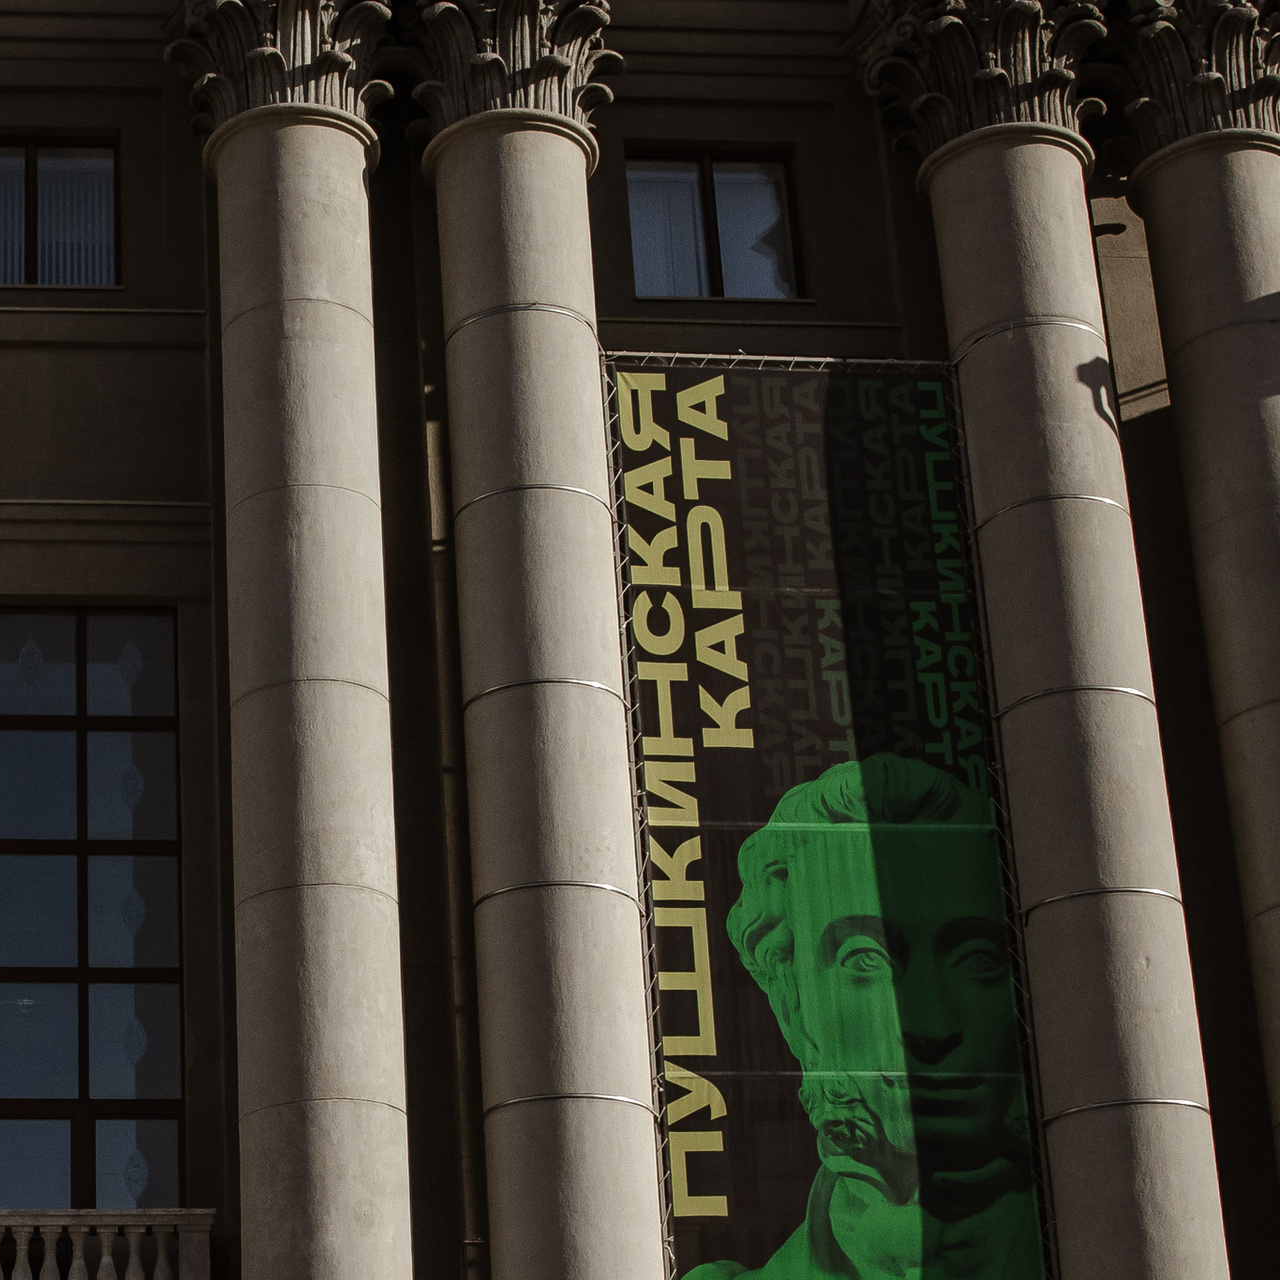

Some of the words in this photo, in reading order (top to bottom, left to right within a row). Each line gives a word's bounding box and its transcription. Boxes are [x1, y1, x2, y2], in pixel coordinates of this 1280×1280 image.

[676, 375, 754, 749] КАРТА
[814, 598, 858, 760] КАРТ
[909, 600, 954, 766] КАРТ
[917, 381, 989, 791] ПУШКИНСКАЯ
[617, 372, 728, 1217] ПУШКИНСКАЯ
